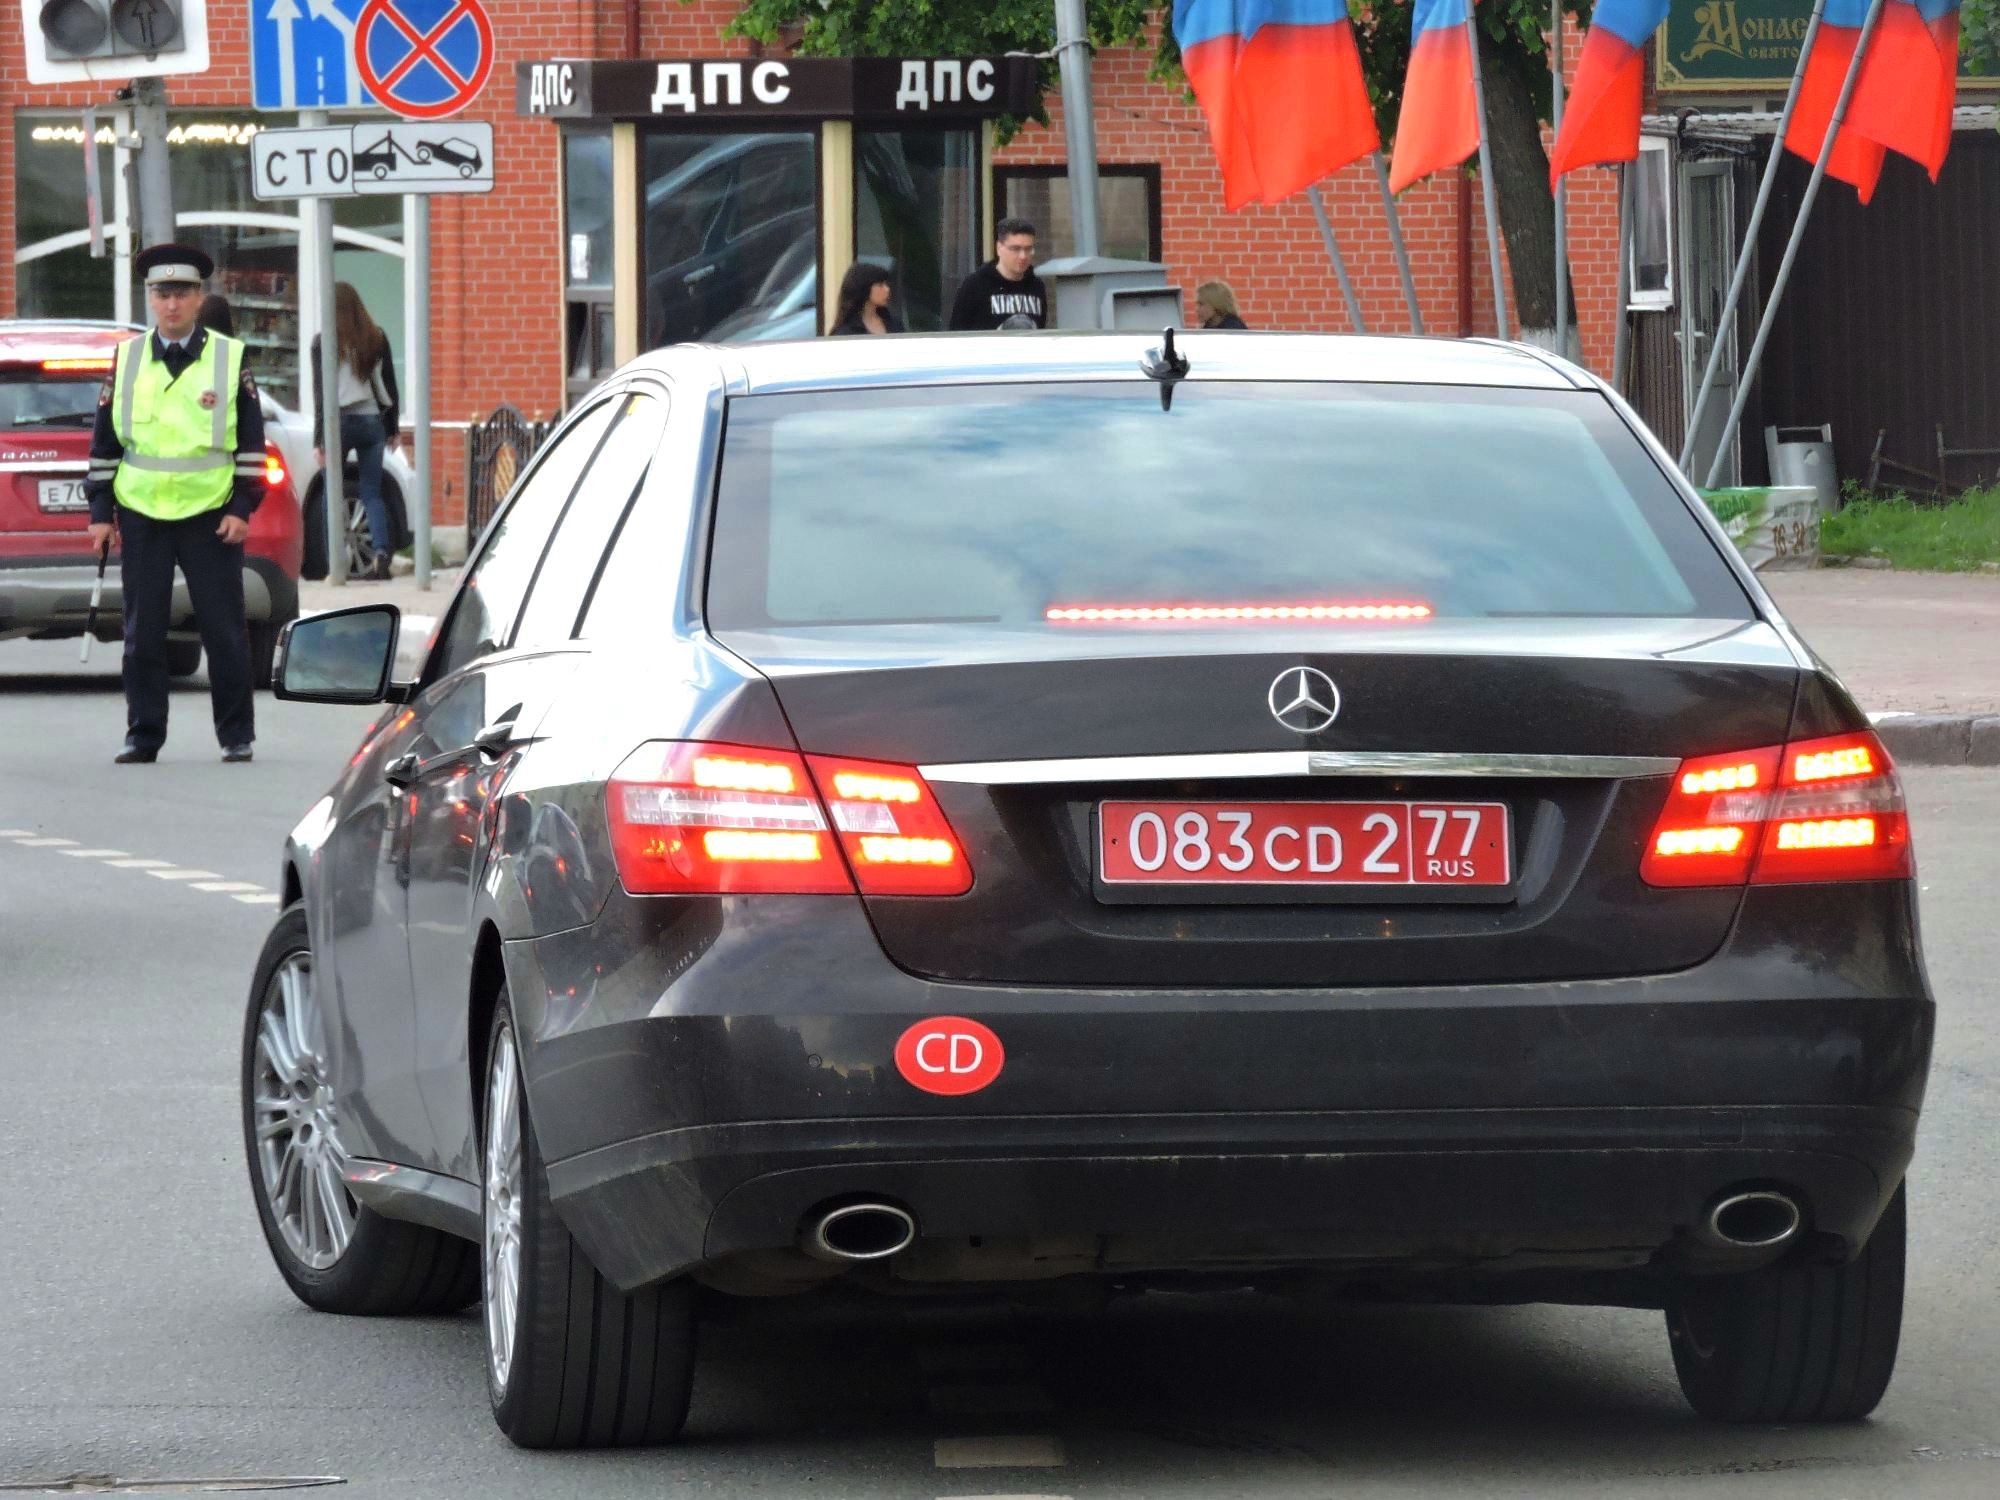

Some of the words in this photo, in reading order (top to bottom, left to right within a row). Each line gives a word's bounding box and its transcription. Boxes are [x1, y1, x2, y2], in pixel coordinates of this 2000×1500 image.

[530, 63, 574, 114] ДПС
[651, 61, 791, 113] ДПС
[896, 59, 995, 110] ДПС
[266, 147, 349, 187] СТО
[1418, 810, 1481, 857] 77
[1428, 860, 1476, 878] RUS
[915, 1032, 983, 1074] CD
